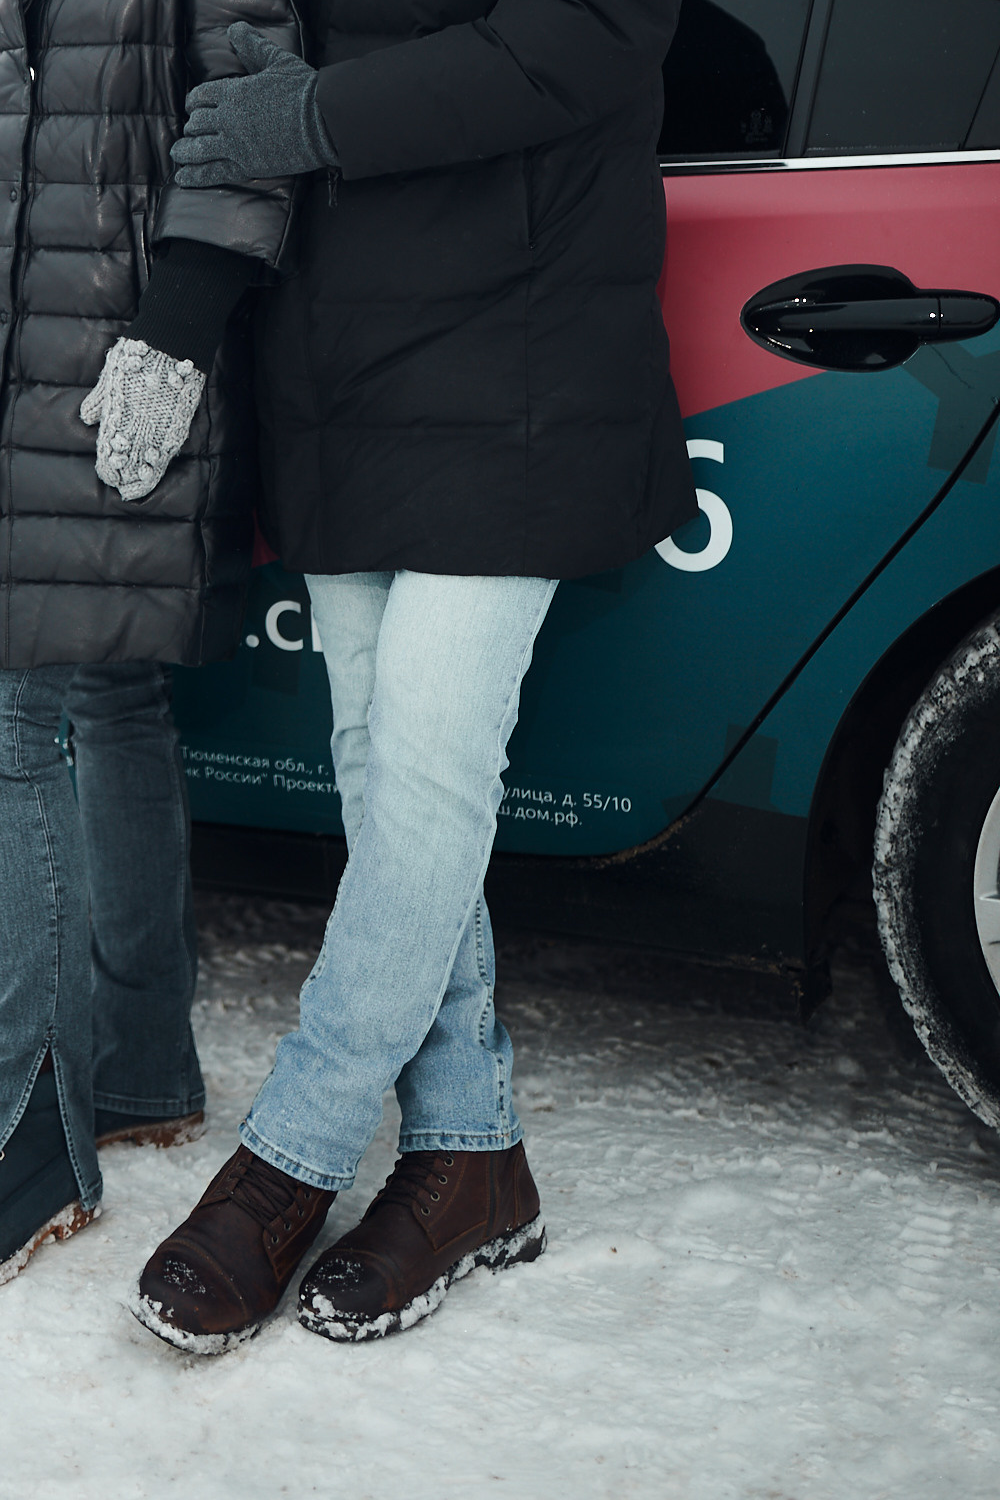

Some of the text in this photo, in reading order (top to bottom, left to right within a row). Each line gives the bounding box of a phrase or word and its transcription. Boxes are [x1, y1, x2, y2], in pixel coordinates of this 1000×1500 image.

[179, 746, 270, 768] Тюменская
[317, 763, 329, 776] г.
[205, 765, 268, 786] России"
[503, 786, 632, 812] улица, д. 55/10
